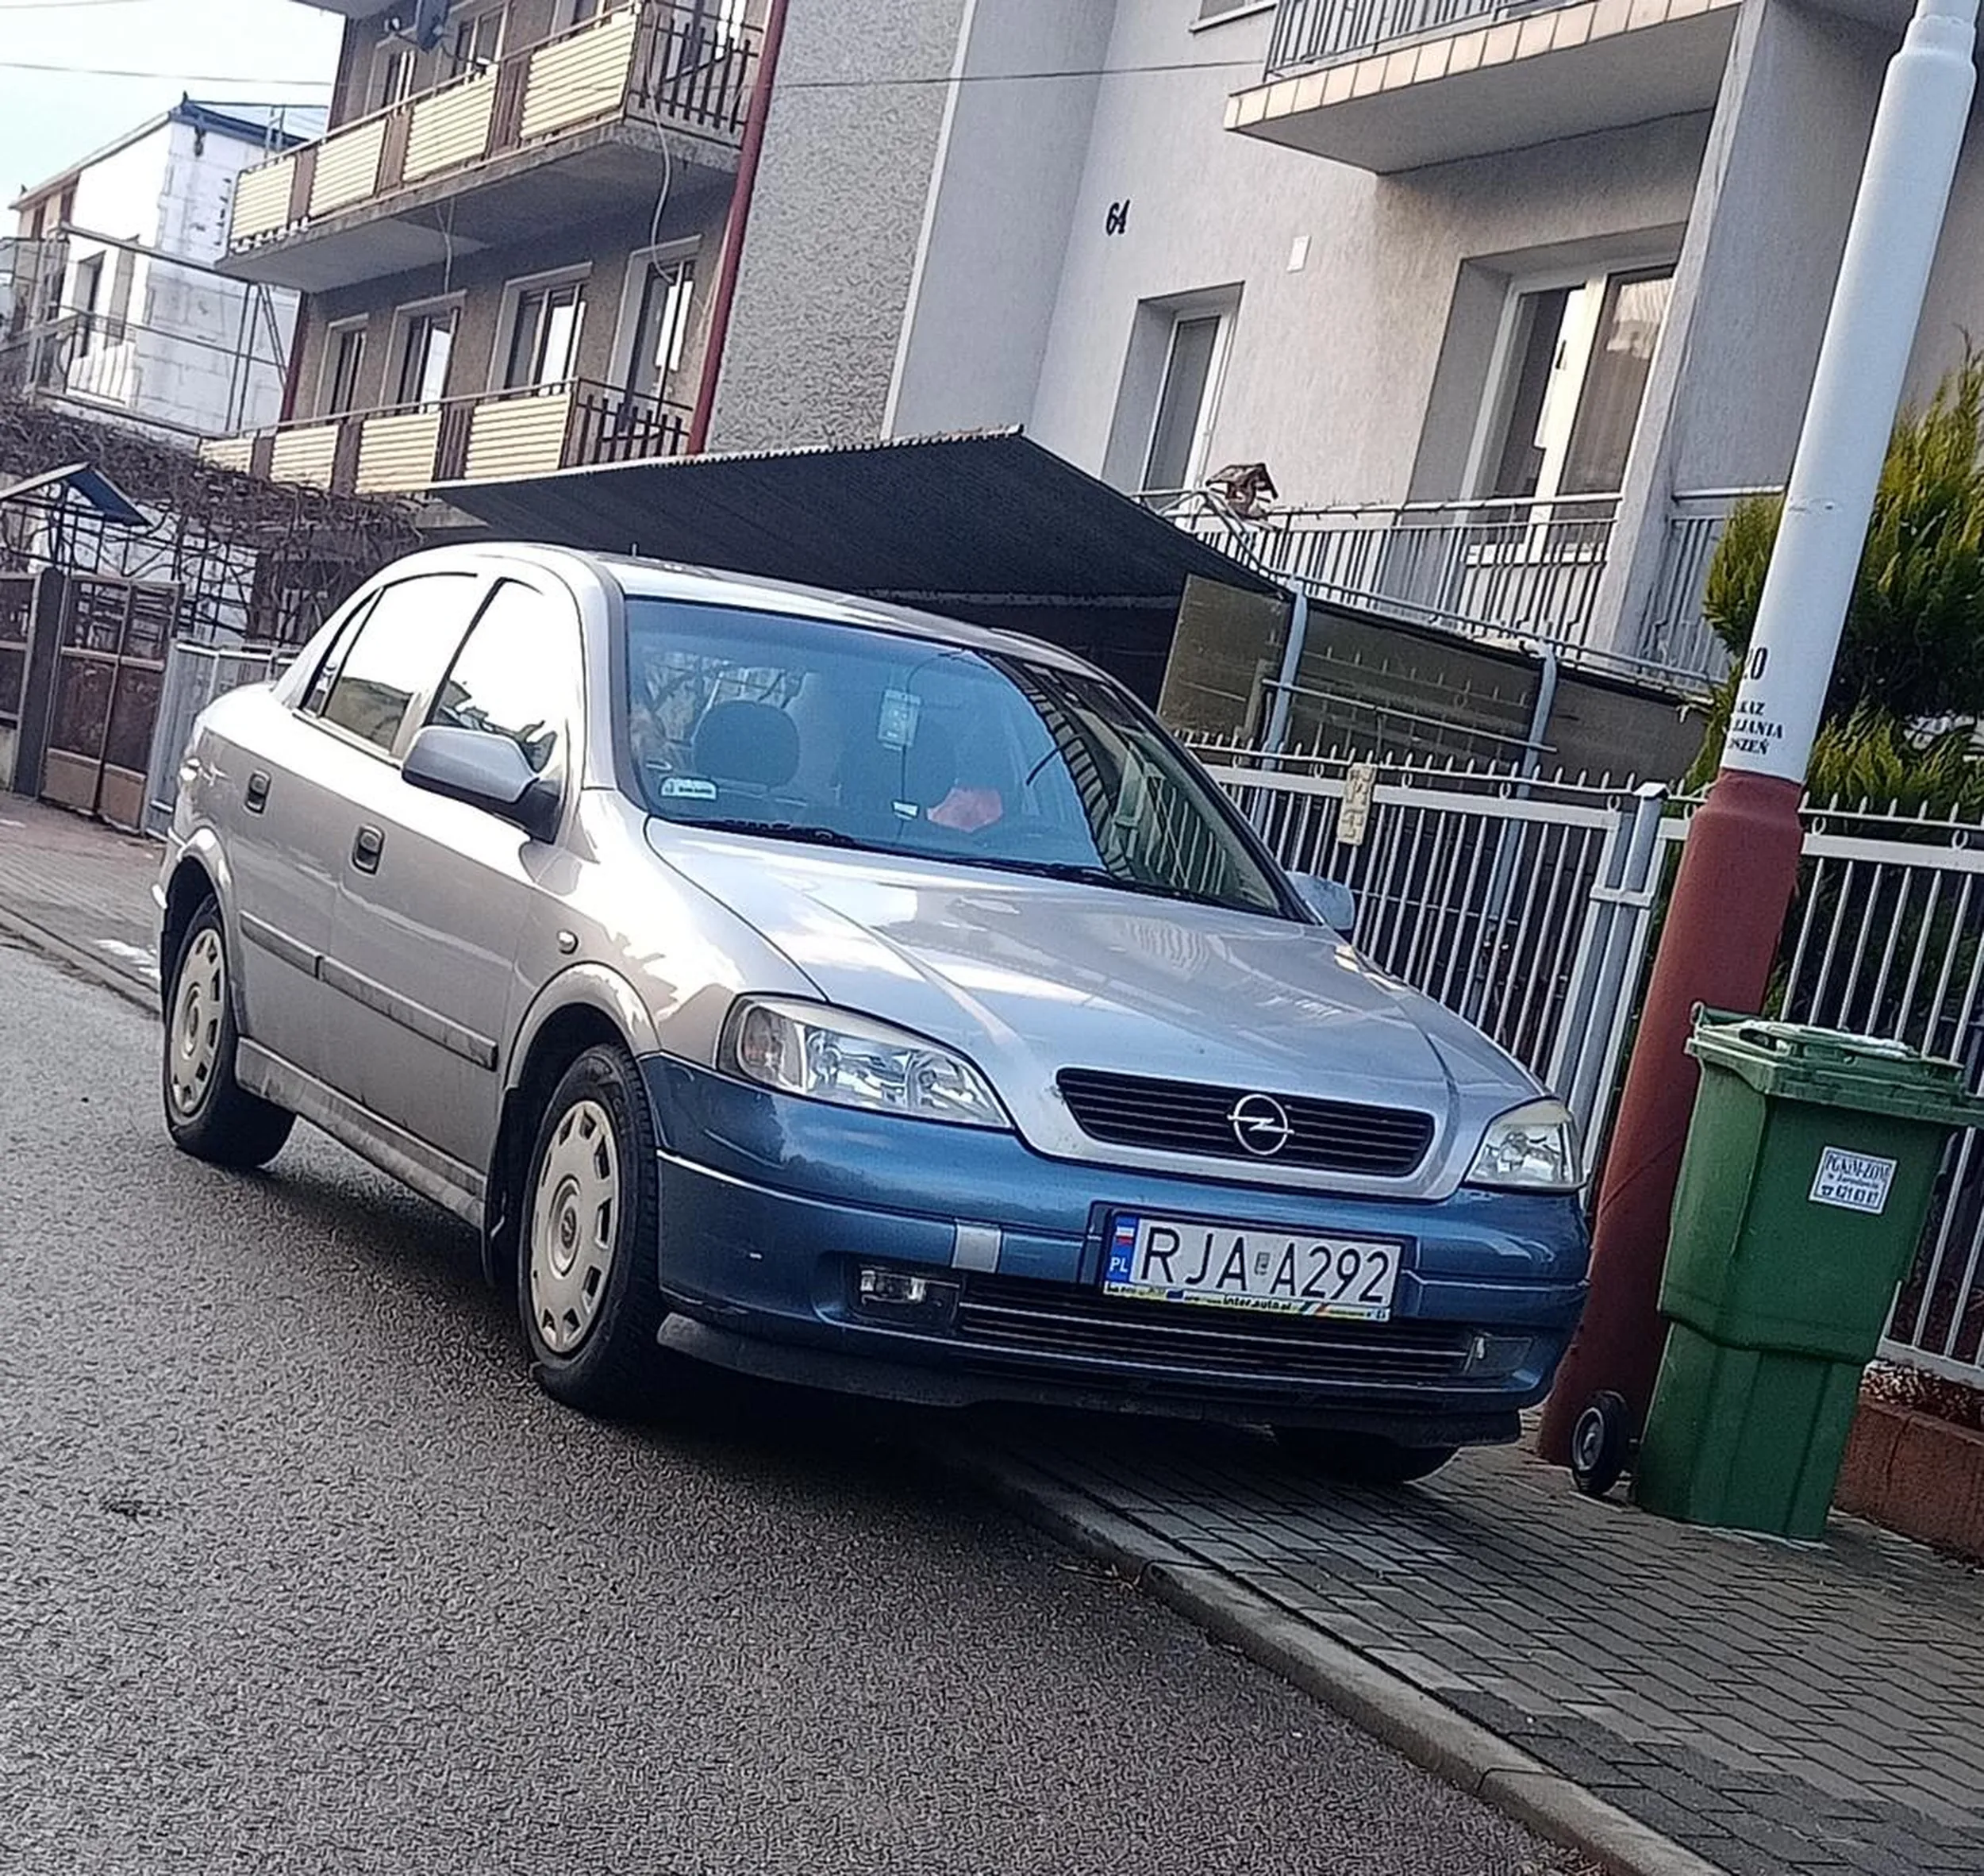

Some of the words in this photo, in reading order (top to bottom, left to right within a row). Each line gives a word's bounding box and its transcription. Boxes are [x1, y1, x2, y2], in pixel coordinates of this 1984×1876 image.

[1106, 198, 1130, 236] 64
[1109, 1255, 1128, 1273] PL
[1140, 1225, 1248, 1291] RJA
[1271, 1242, 1390, 1303] A292
